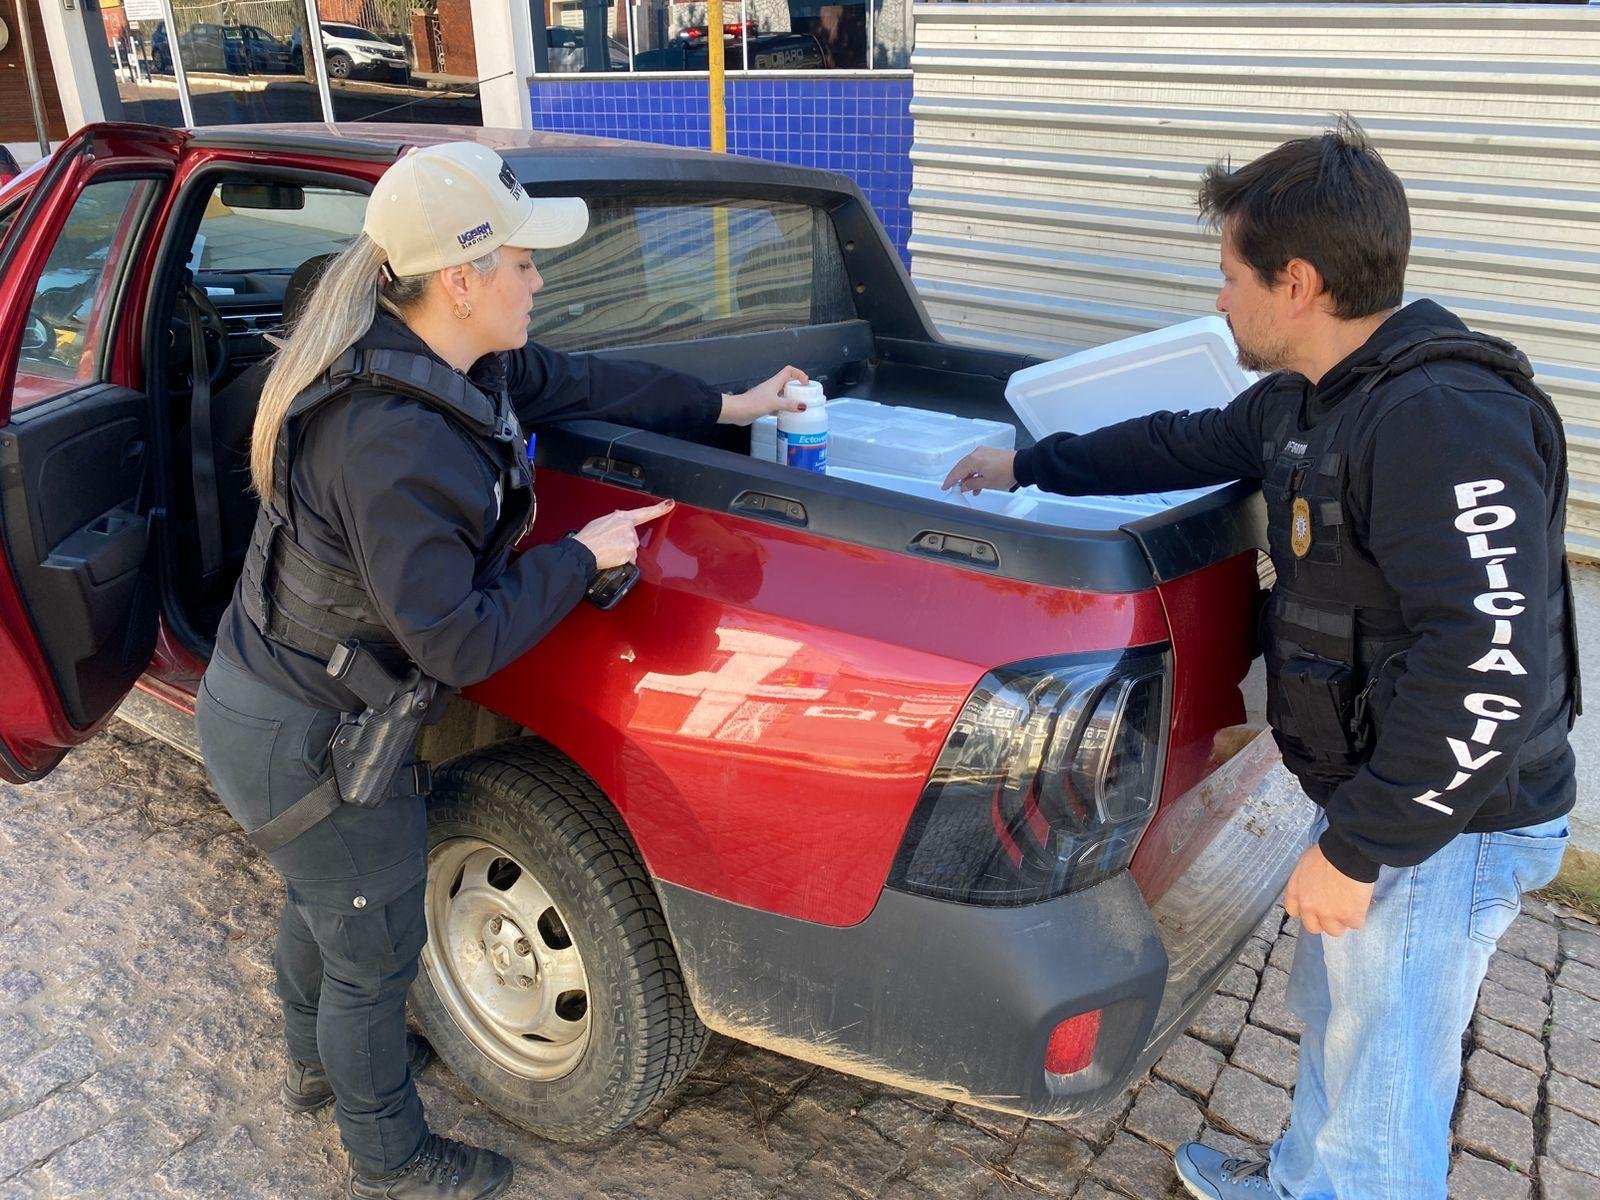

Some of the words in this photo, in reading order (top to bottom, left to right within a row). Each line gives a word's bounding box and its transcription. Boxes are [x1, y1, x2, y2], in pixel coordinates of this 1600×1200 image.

[461, 230, 494, 250] SINDICATO
[1453, 478, 1528, 676] POLÍCIA
[1412, 691, 1522, 816] CIVIL
